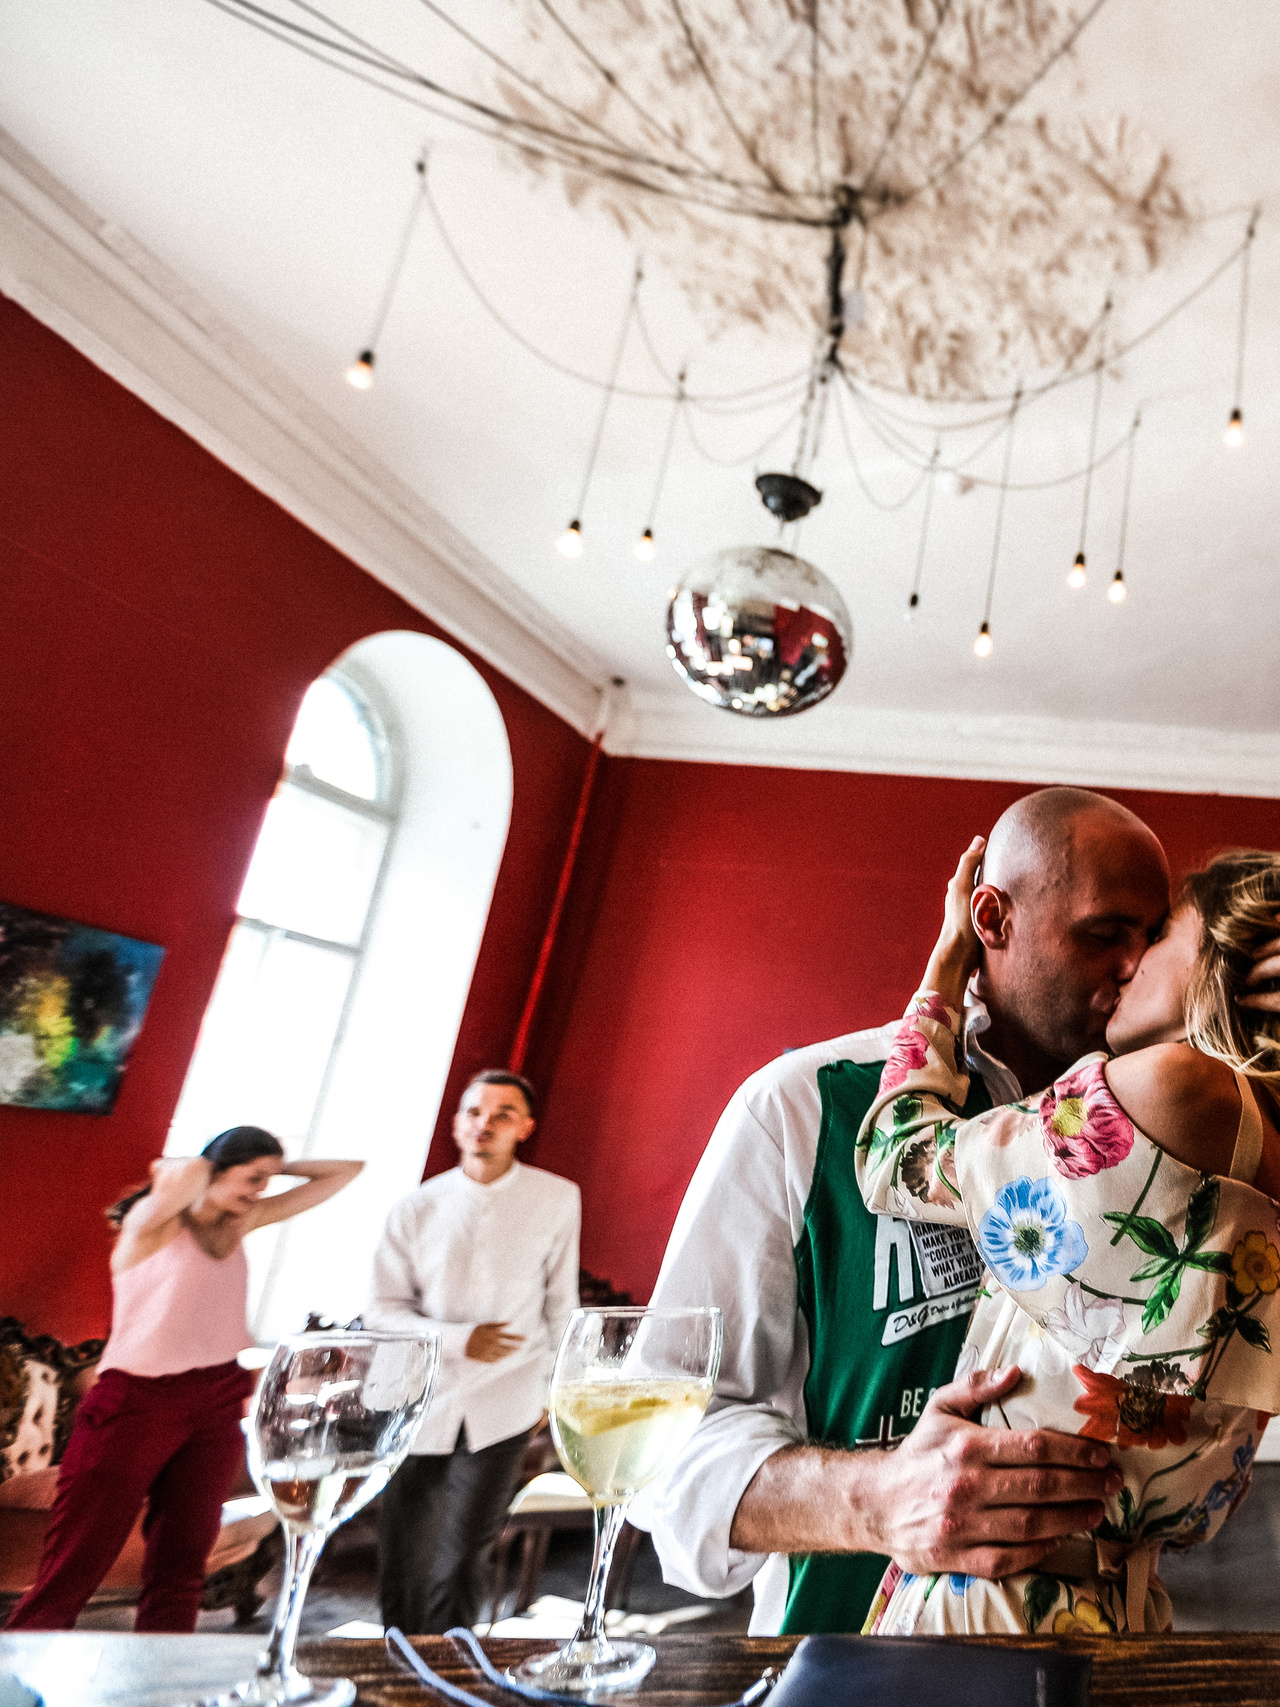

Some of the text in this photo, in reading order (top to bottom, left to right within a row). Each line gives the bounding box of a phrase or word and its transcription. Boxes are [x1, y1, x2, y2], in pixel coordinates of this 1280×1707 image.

[922, 1233, 947, 1250] MAKE
[947, 1229, 965, 1242] YOU
[931, 1259, 955, 1278] WHAT
[956, 1254, 974, 1269] YOU
[944, 1265, 981, 1289] ALREADY
[893, 1304, 929, 1333] D&G
